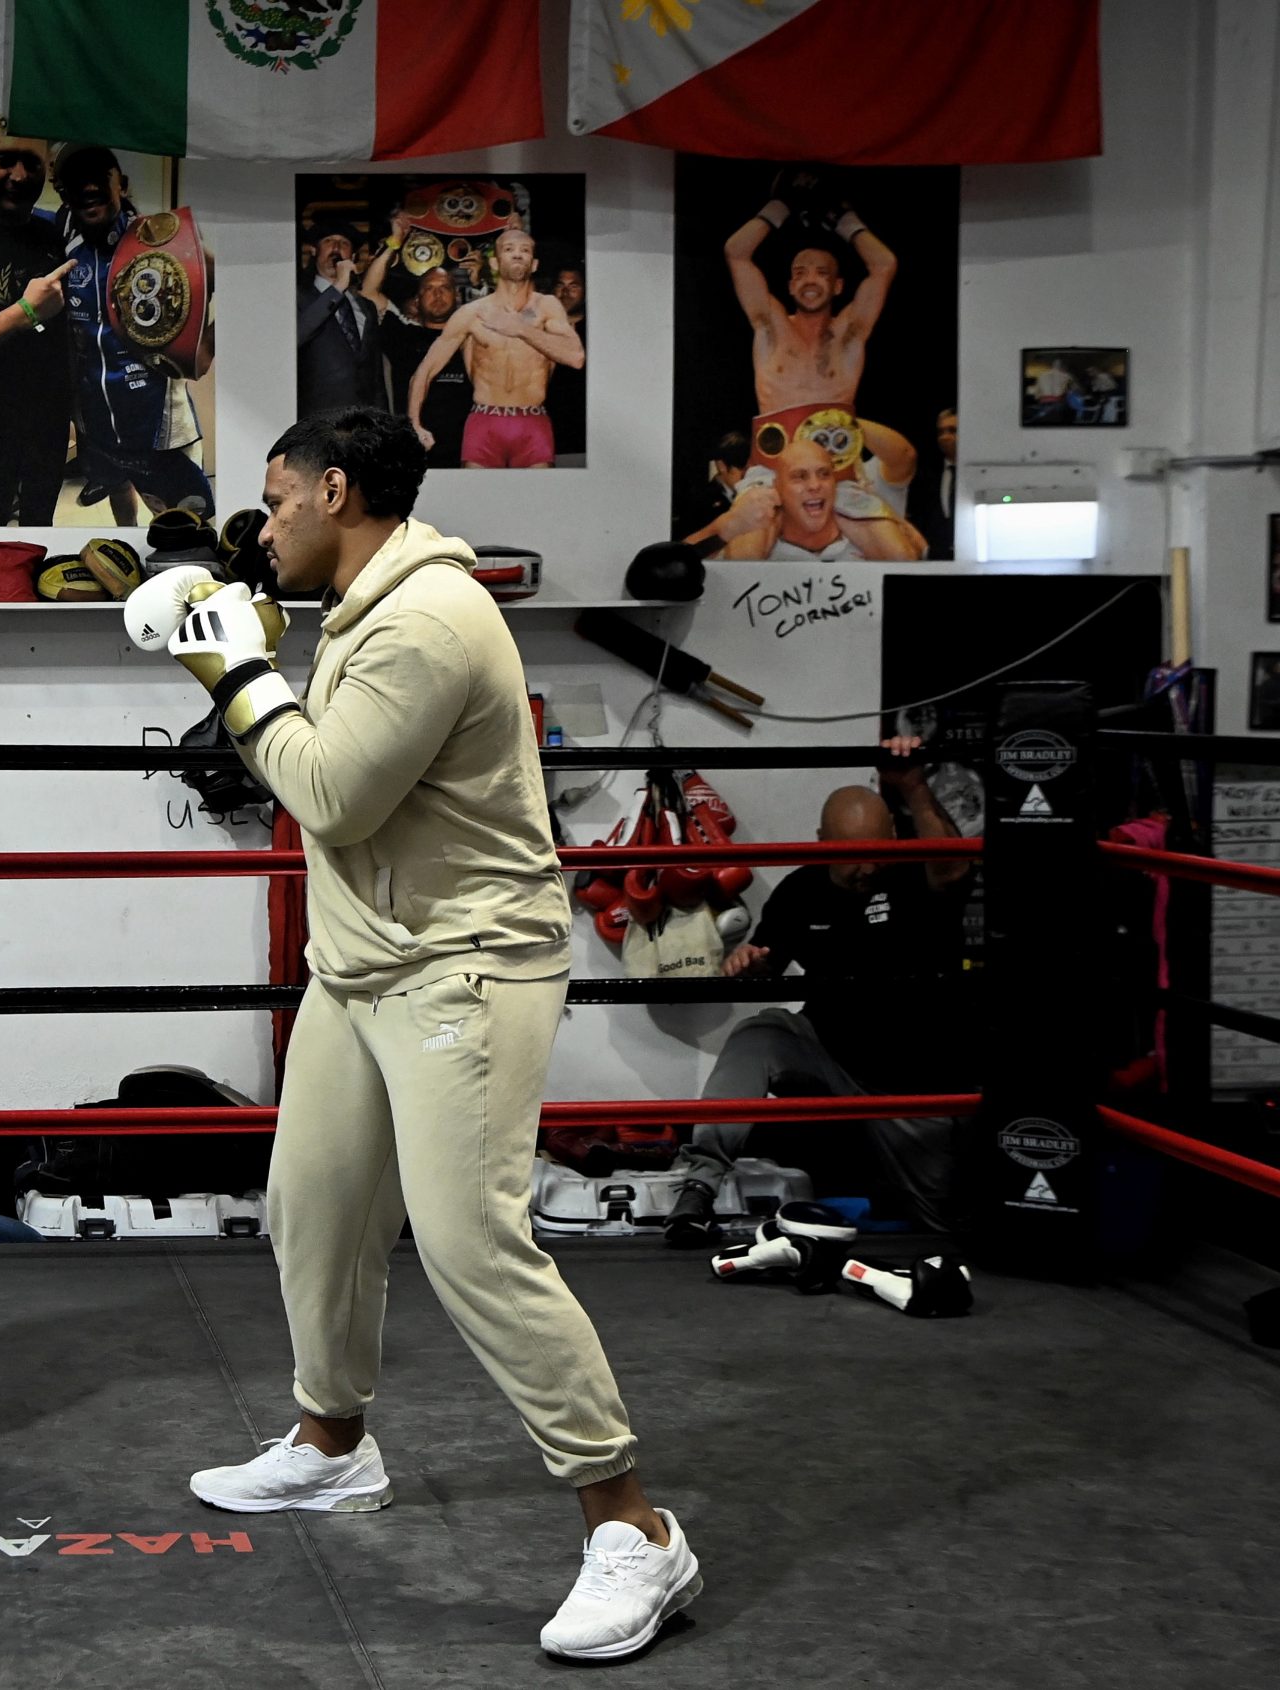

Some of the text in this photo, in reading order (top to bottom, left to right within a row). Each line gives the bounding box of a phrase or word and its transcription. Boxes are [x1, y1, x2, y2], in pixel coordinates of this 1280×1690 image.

[733, 575, 846, 627] TONY'S
[776, 591, 873, 638] CORNER!
[141, 633, 160, 642] adidas
[1000, 750, 1072, 762] JIM BRADLEY
[685, 956, 704, 966] Bag
[422, 1032, 454, 1052] PUMA
